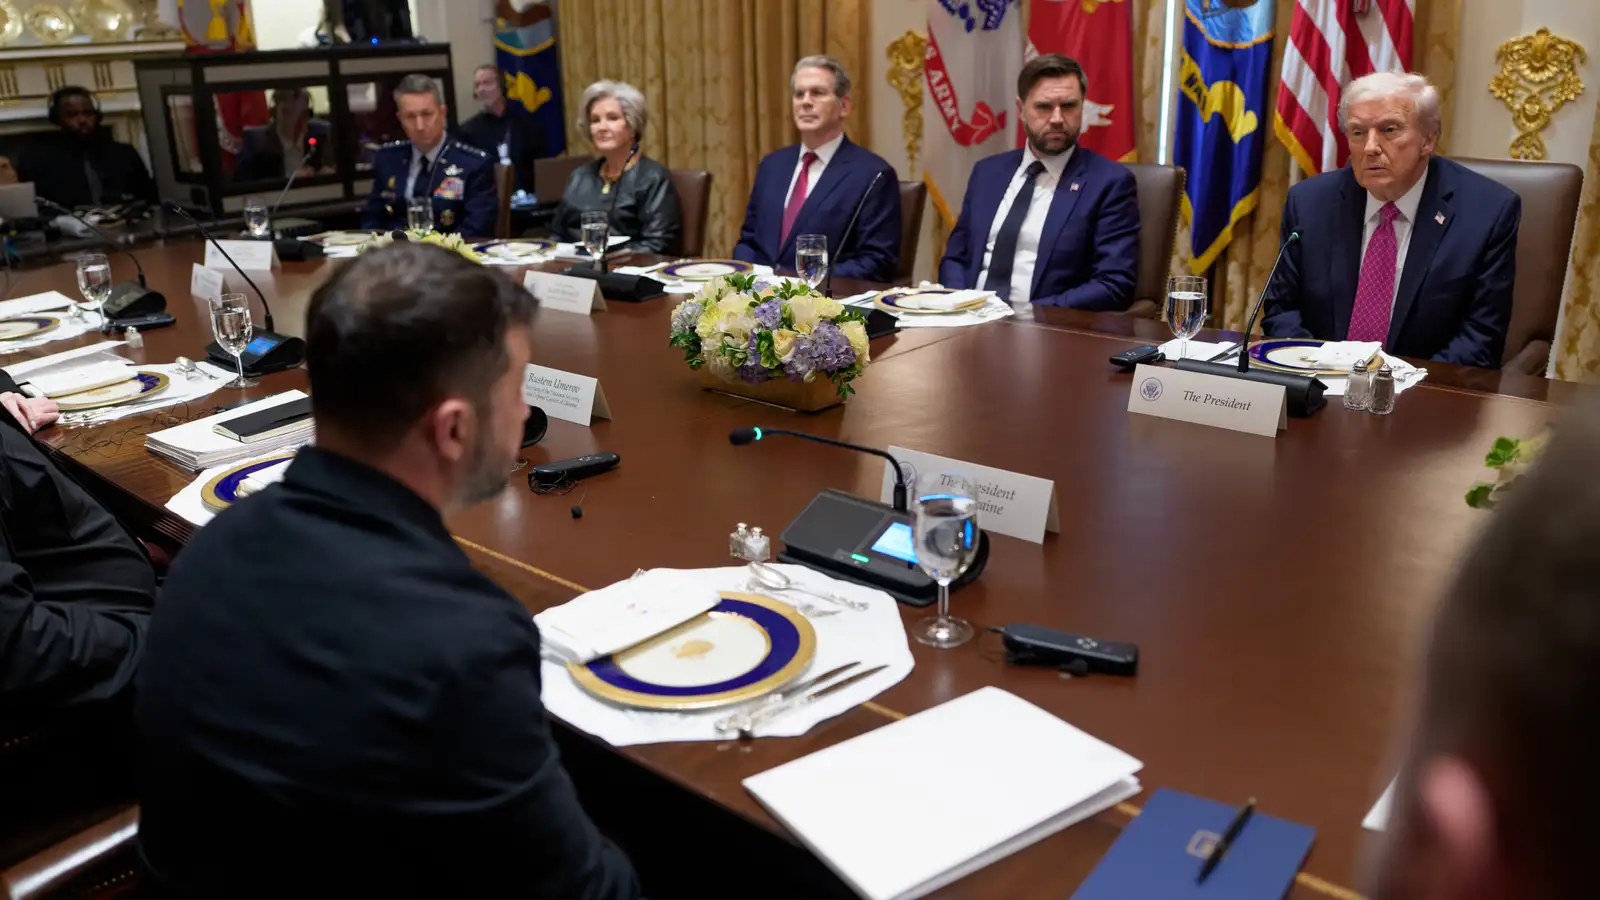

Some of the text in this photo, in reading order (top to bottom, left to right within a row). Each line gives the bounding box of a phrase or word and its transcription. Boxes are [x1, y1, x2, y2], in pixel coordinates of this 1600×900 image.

[928, 69, 960, 131] ARMY
[528, 372, 581, 393] Rustem Umerov
[1183, 390, 1252, 411] The President
[940, 473, 1016, 501] The Pesident
